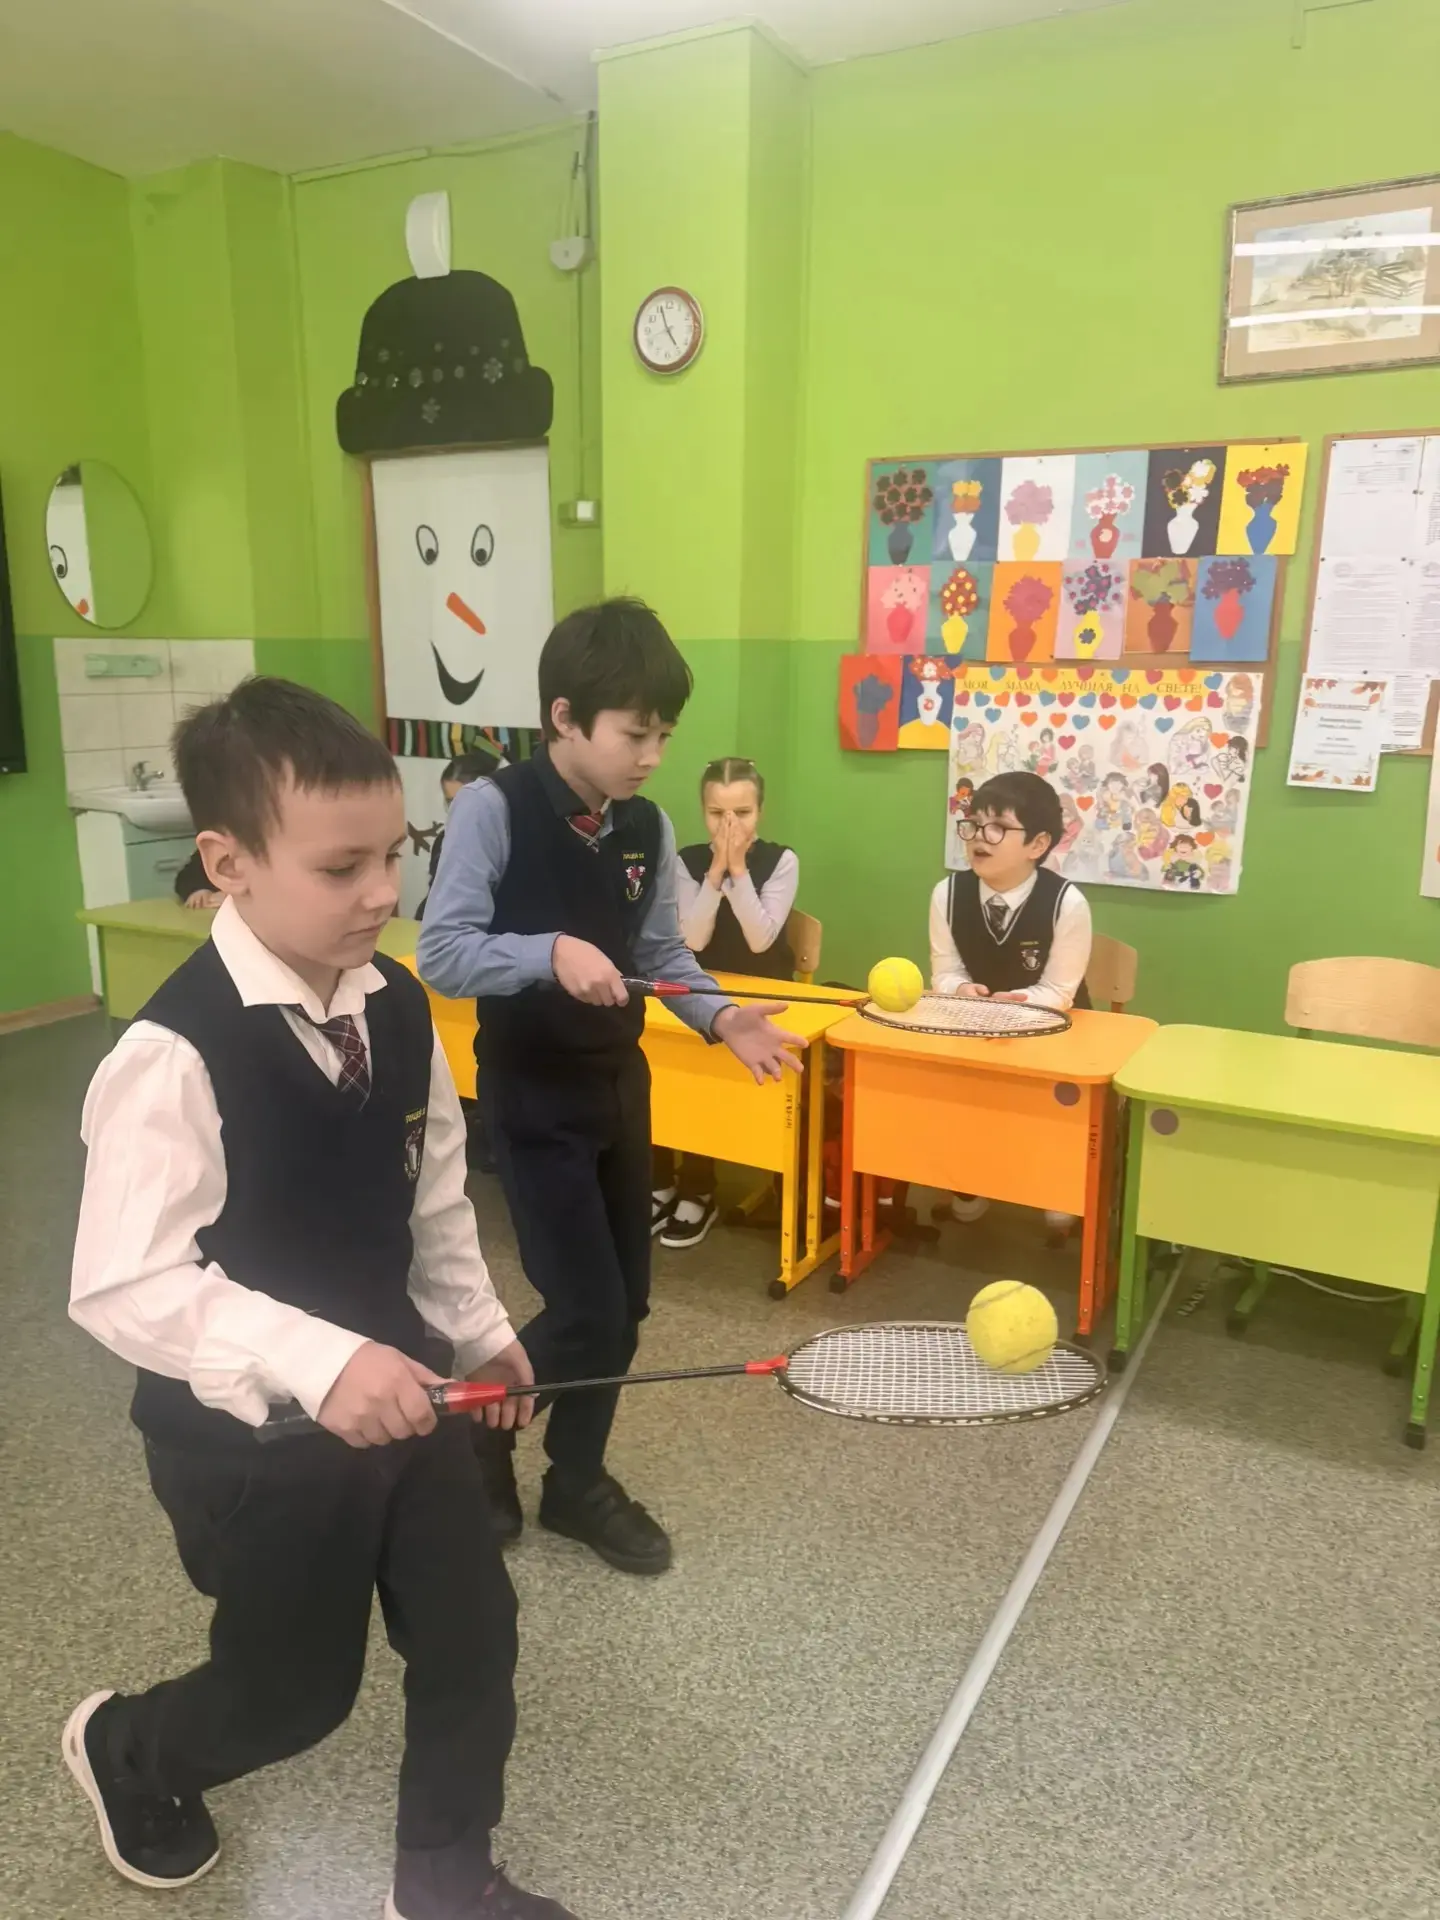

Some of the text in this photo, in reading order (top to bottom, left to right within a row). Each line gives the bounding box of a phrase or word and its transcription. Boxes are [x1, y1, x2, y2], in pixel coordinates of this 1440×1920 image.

[665, 300, 675, 310] 12
[963, 680, 1202, 694] МОЯ МАМА ЛУЧШАЯ НА СВЕТЕ!
